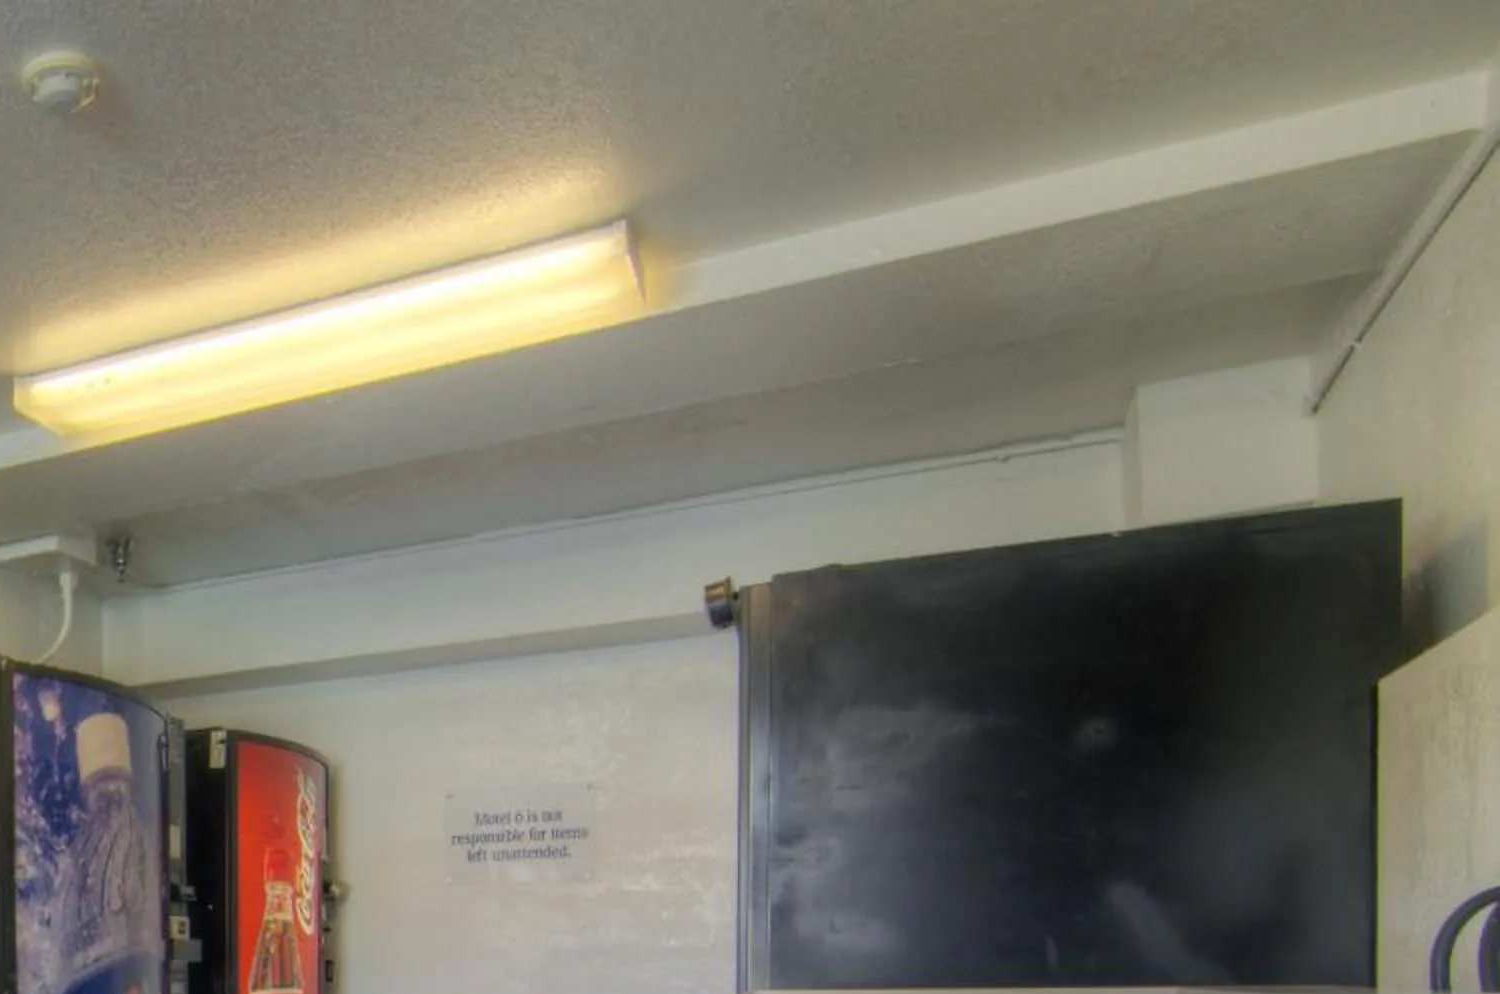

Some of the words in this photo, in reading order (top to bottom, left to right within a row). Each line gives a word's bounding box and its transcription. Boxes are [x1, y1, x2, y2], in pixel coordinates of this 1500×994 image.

[474, 811, 511, 827] Motel
[529, 826, 547, 841] for
[467, 848, 487, 863] left
